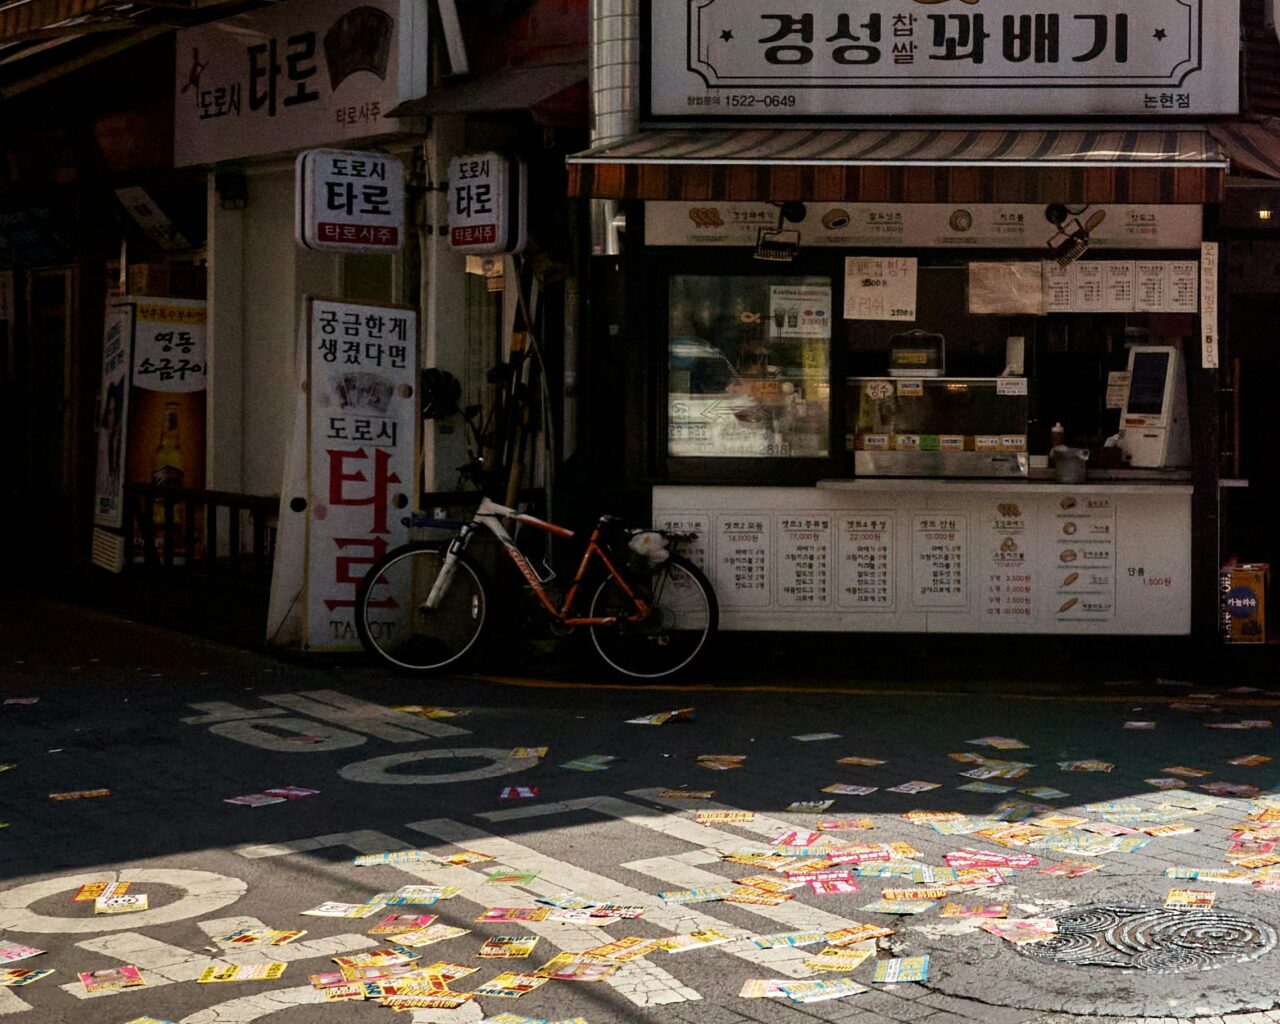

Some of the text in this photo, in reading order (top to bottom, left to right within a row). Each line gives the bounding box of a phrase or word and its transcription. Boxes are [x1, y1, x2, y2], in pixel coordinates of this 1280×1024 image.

[758, 13, 1129, 64] 경성 찹쌀 꽈배기
[200, 32, 319, 119] 도로시 타로
[725, 95, 796, 107] 1522-0649
[1144, 92, 1190, 109] 논현점
[336, 101, 381, 125] 타로사주
[331, 159, 386, 181] 도로시
[458, 159, 490, 180] 도로시
[325, 182, 391, 215] 타로
[455, 184, 492, 217] 타로
[325, 225, 392, 241] 타로사주
[455, 227, 493, 242] 타로사주
[319, 310, 408, 342] 궁금한게
[153, 332, 196, 353] 영동
[318, 339, 407, 369] 생겼다면
[870, 384, 890, 398] 빙수
[327, 417, 397, 447] 도로시
[325, 447, 402, 612] 타로
[1143, 577, 1172, 587] 1,500원
[329, 620, 396, 638] TAOT
